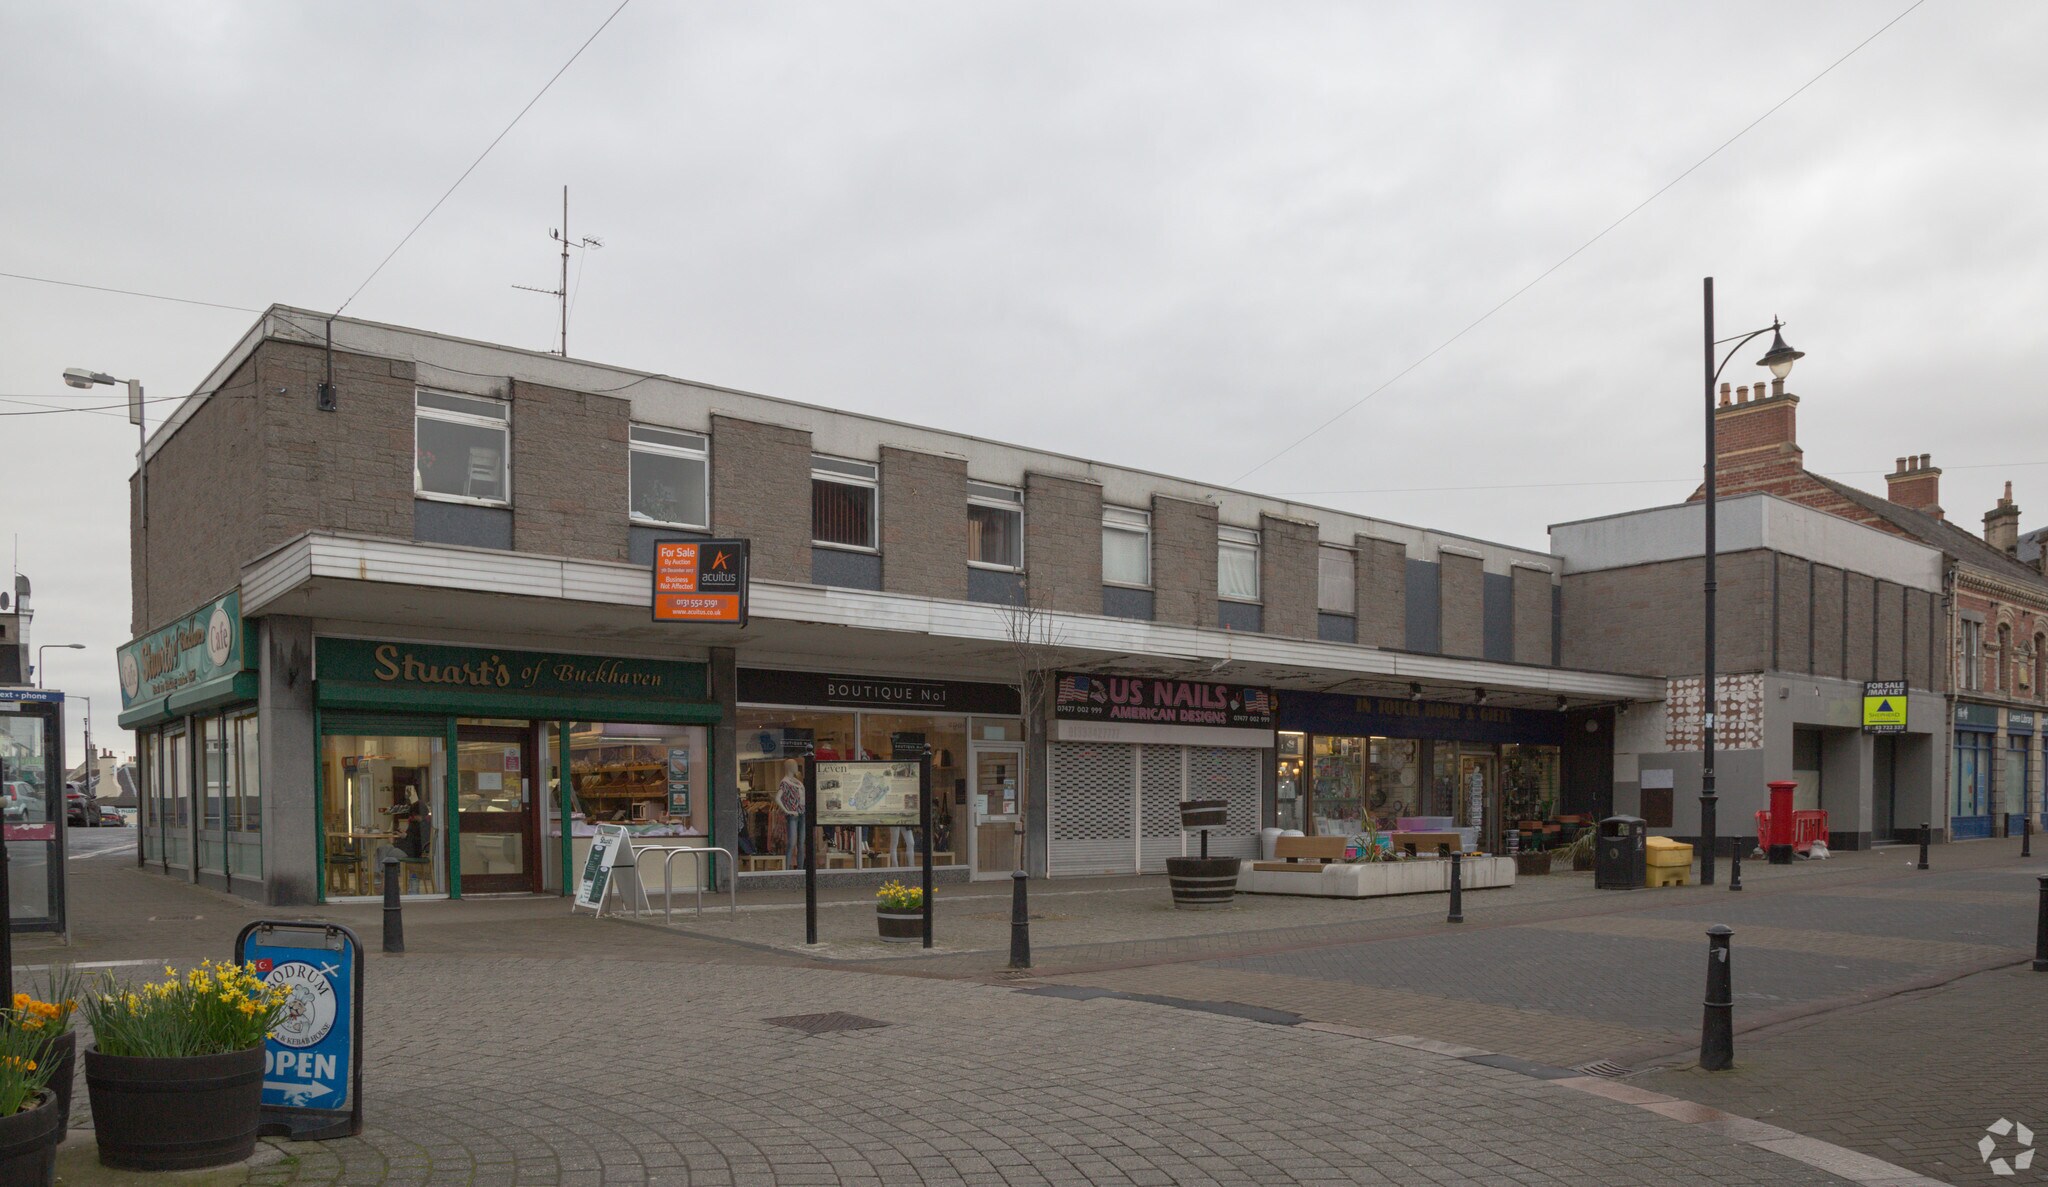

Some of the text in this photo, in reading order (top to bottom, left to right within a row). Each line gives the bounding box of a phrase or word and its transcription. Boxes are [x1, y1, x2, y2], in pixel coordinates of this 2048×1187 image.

[661, 547, 695, 557] For Sale
[702, 571, 736, 582] acuitus
[676, 599, 690, 607] 0131
[704, 600, 718, 608] 5191
[210, 620, 228, 653] Cafe
[374, 645, 663, 688] Stuart's of Buckhaven
[828, 684, 912, 700] BOUTIQUE
[1867, 682, 1883, 690] FOR
[21, 692, 47, 700] phone
[1109, 678, 1228, 709] US NAILS
[1091, 706, 1103, 714] 999
[1110, 705, 1227, 725] AMERICAN DESIGNS
[817, 763, 847, 774] Leven
[266, 964, 329, 996] BODRUM
[286, 1035, 311, 1045] KEBAB
[310, 1023, 331, 1043] HOUSE
